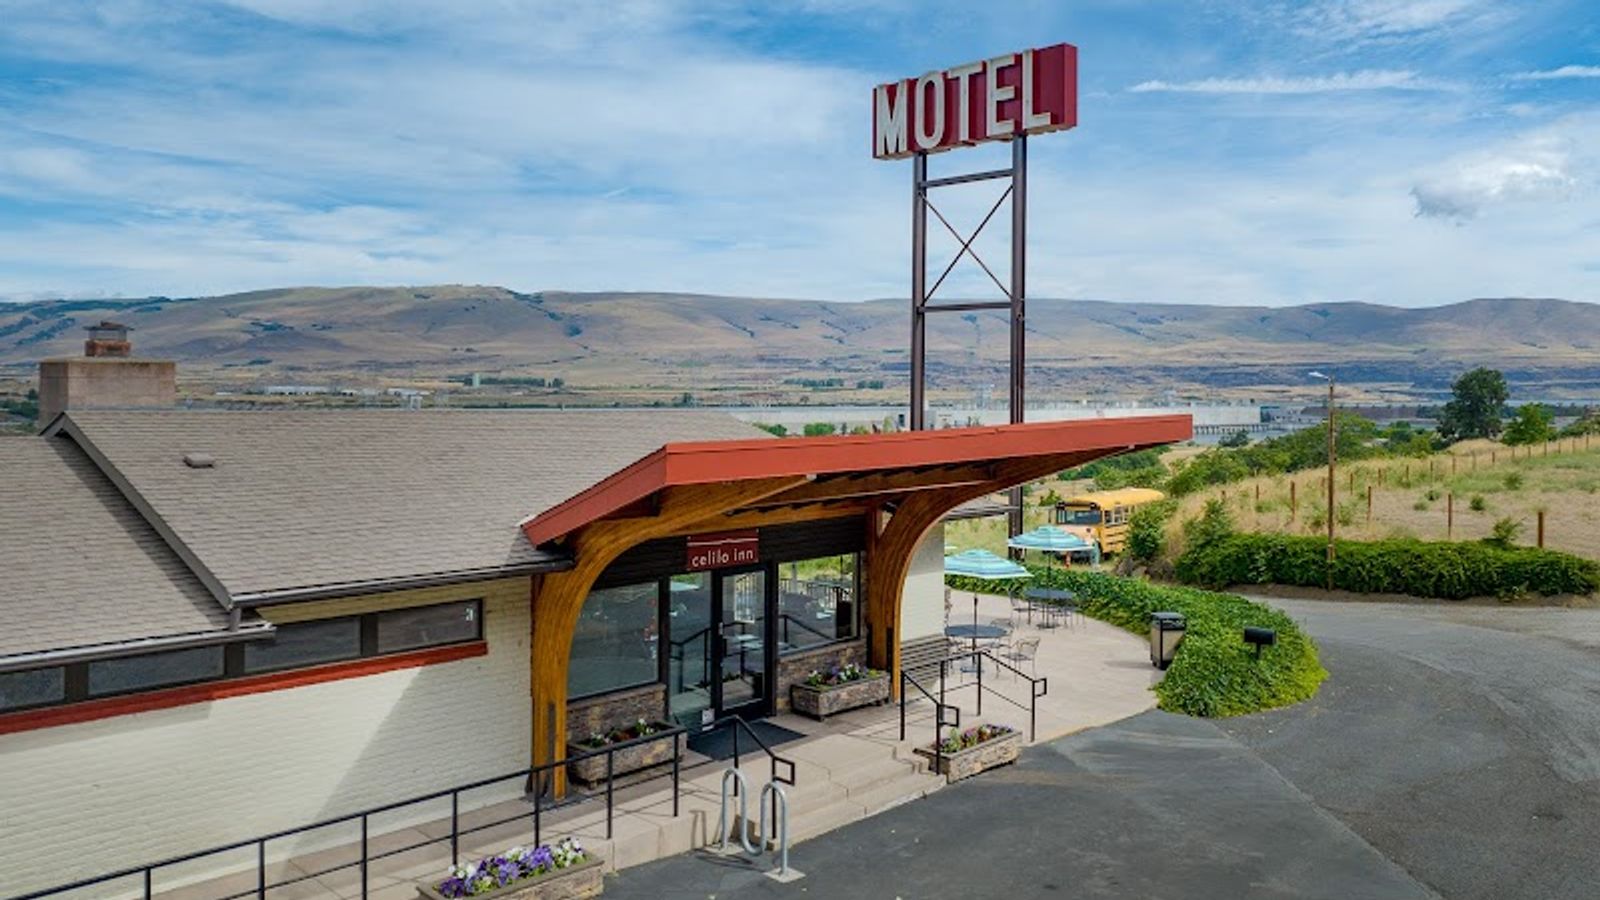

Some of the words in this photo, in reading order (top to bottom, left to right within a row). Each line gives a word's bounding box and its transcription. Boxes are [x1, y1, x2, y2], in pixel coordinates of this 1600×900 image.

[876, 49, 1051, 156] MOTEL
[691, 549, 729, 567] celilo
[734, 548, 753, 561] inn
